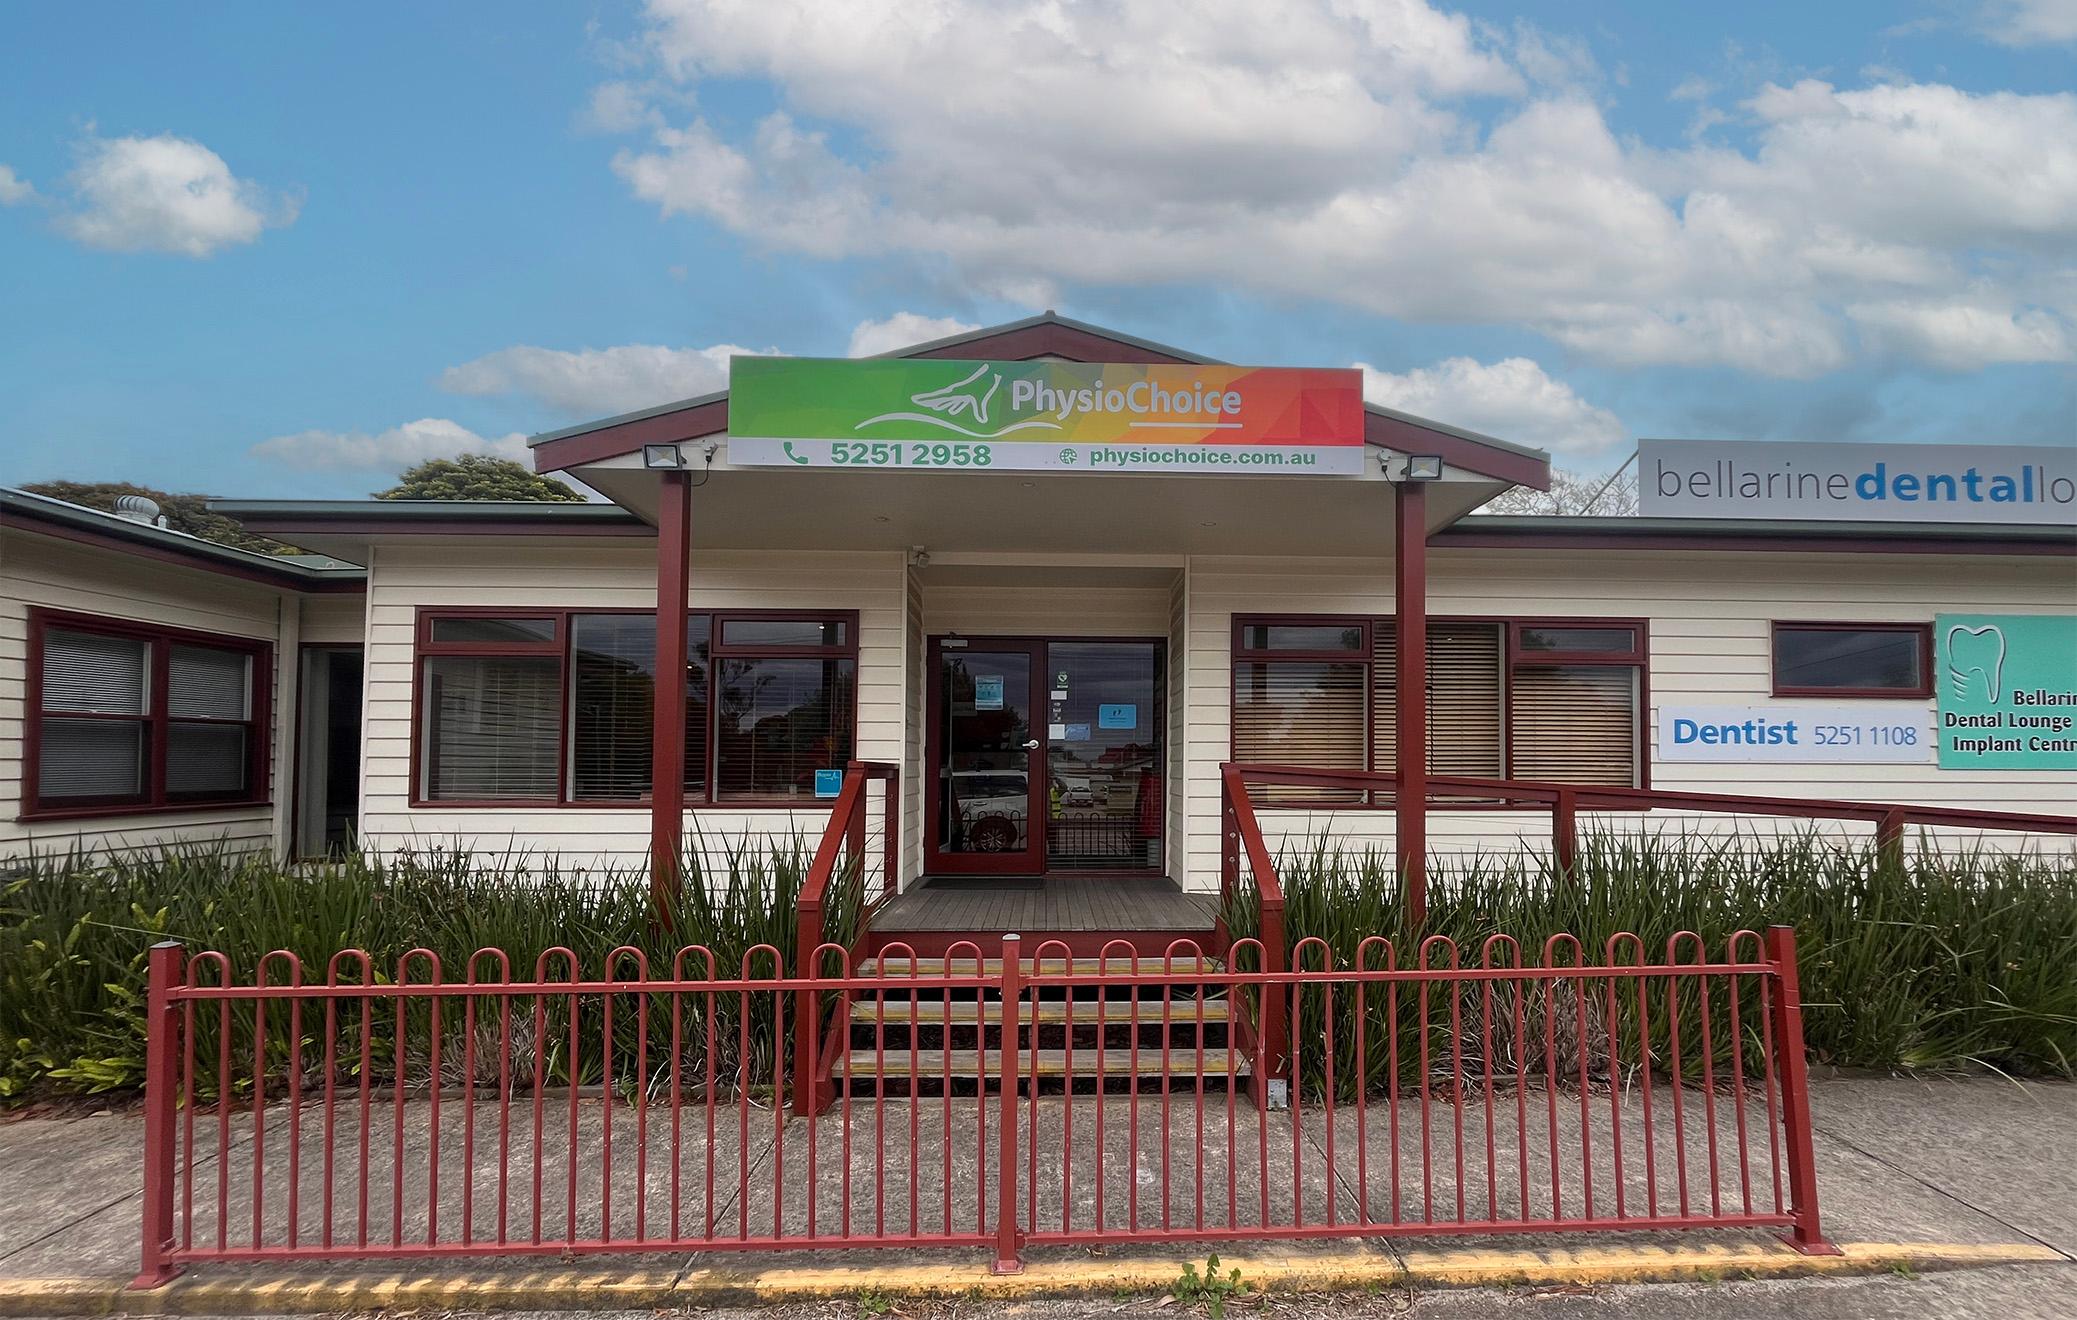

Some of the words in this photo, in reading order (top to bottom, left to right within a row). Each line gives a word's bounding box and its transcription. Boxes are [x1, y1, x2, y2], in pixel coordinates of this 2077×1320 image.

[1012, 379, 1242, 421] PhysioChoice
[831, 442, 902, 465] 5251
[911, 443, 992, 466] 2958
[1090, 447, 1316, 467] physiochoice.com.au
[1673, 718, 1798, 746] Dentist
[1814, 725, 1862, 746] 5251
[1871, 725, 1918, 747] 1108
[1945, 711, 2002, 728] Dental
[2009, 712, 2072, 733] Lounge
[1953, 735, 2022, 756] Implant
